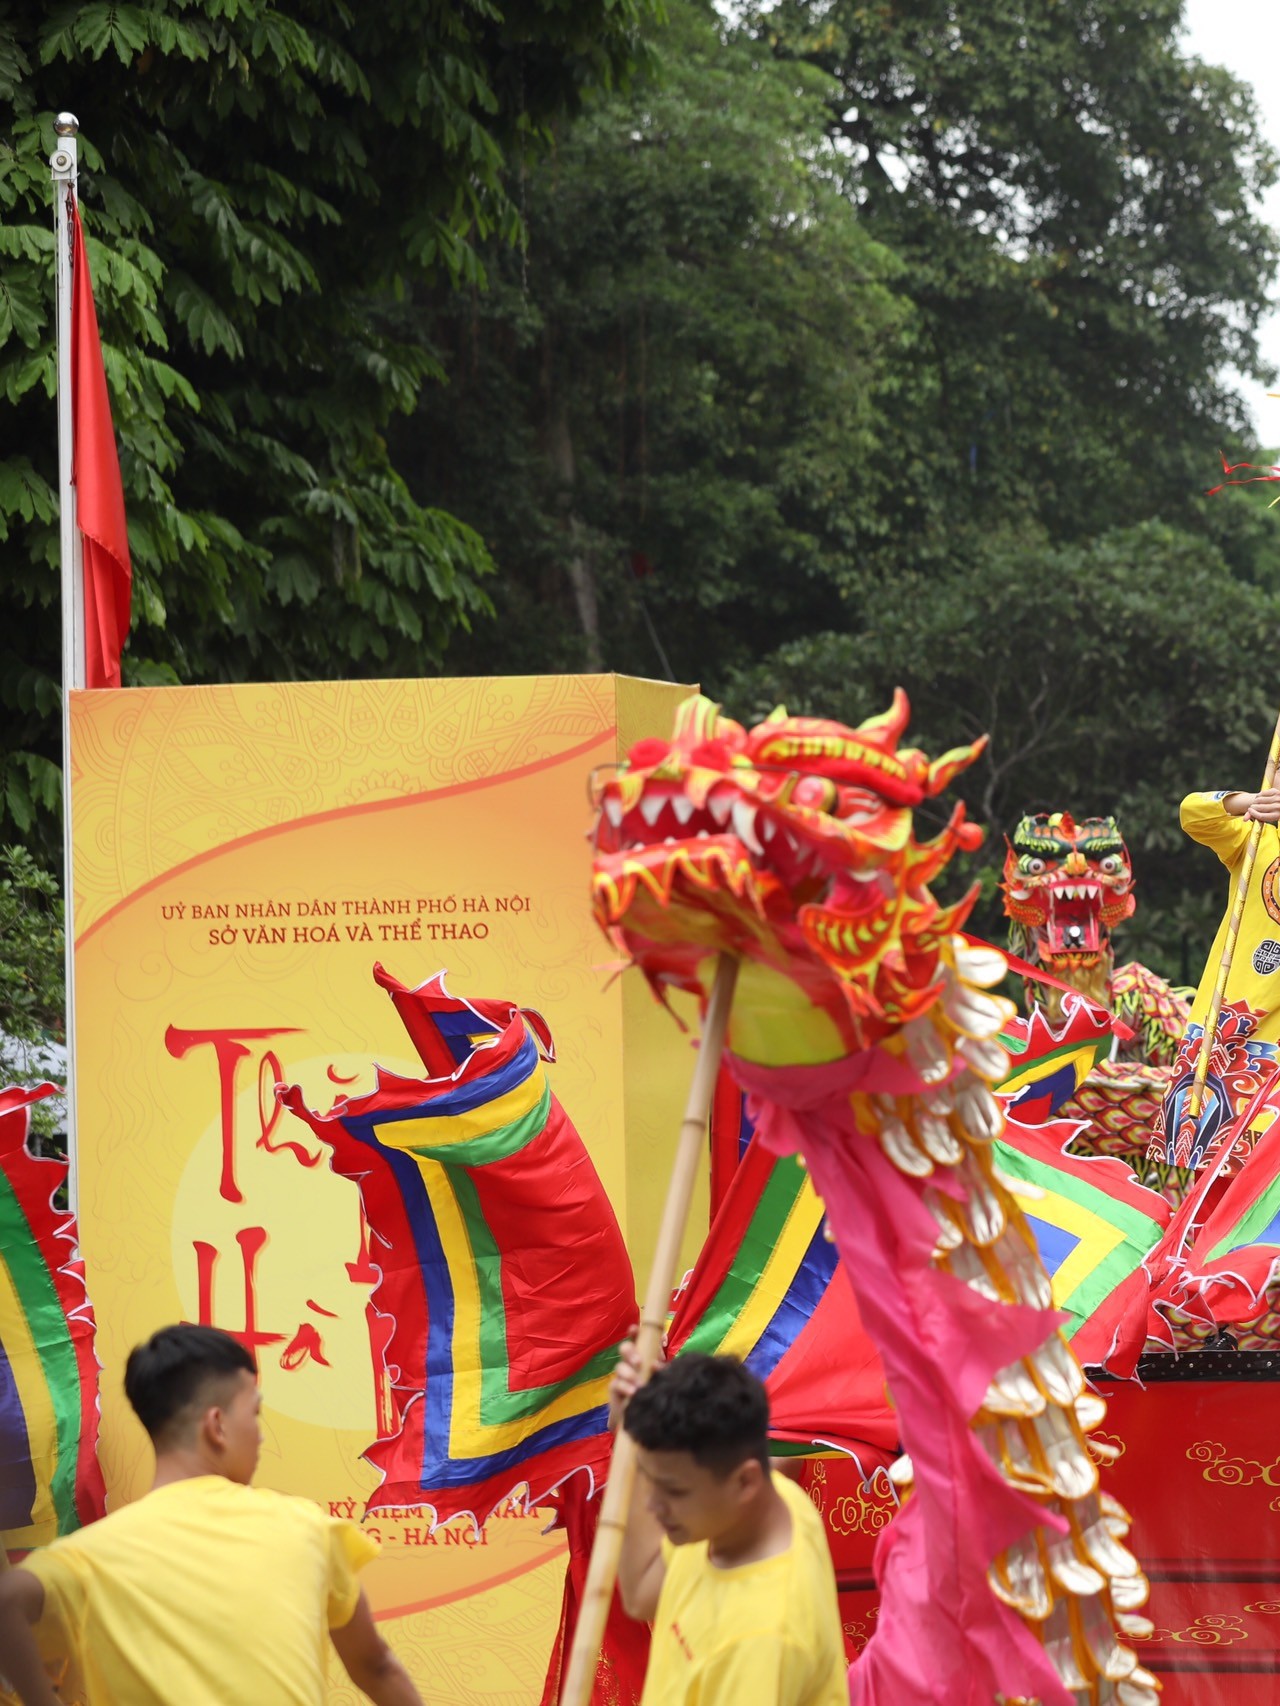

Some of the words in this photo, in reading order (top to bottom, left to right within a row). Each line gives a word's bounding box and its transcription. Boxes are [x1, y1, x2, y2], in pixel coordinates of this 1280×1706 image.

[161, 901, 186, 920] UỶ
[192, 905, 229, 919] BAN
[236, 900, 291, 918] NHÂN
[297, 899, 336, 917] DÂN
[342, 898, 411, 915] THÀNH
[417, 894, 457, 914] PHỐ
[463, 895, 490, 913] HÀ
[495, 894, 531, 915] NỘI
[209, 924, 239, 945] SỞ
[243, 924, 287, 944] VĂN
[293, 922, 341, 943] HOÁ
[346, 922, 374, 941] VÀ
[378, 917, 422, 941] THỂ
[427, 922, 489, 941] THAO
[404, 1523, 438, 1546] HÀ
[444, 1524, 488, 1550] NỘI
